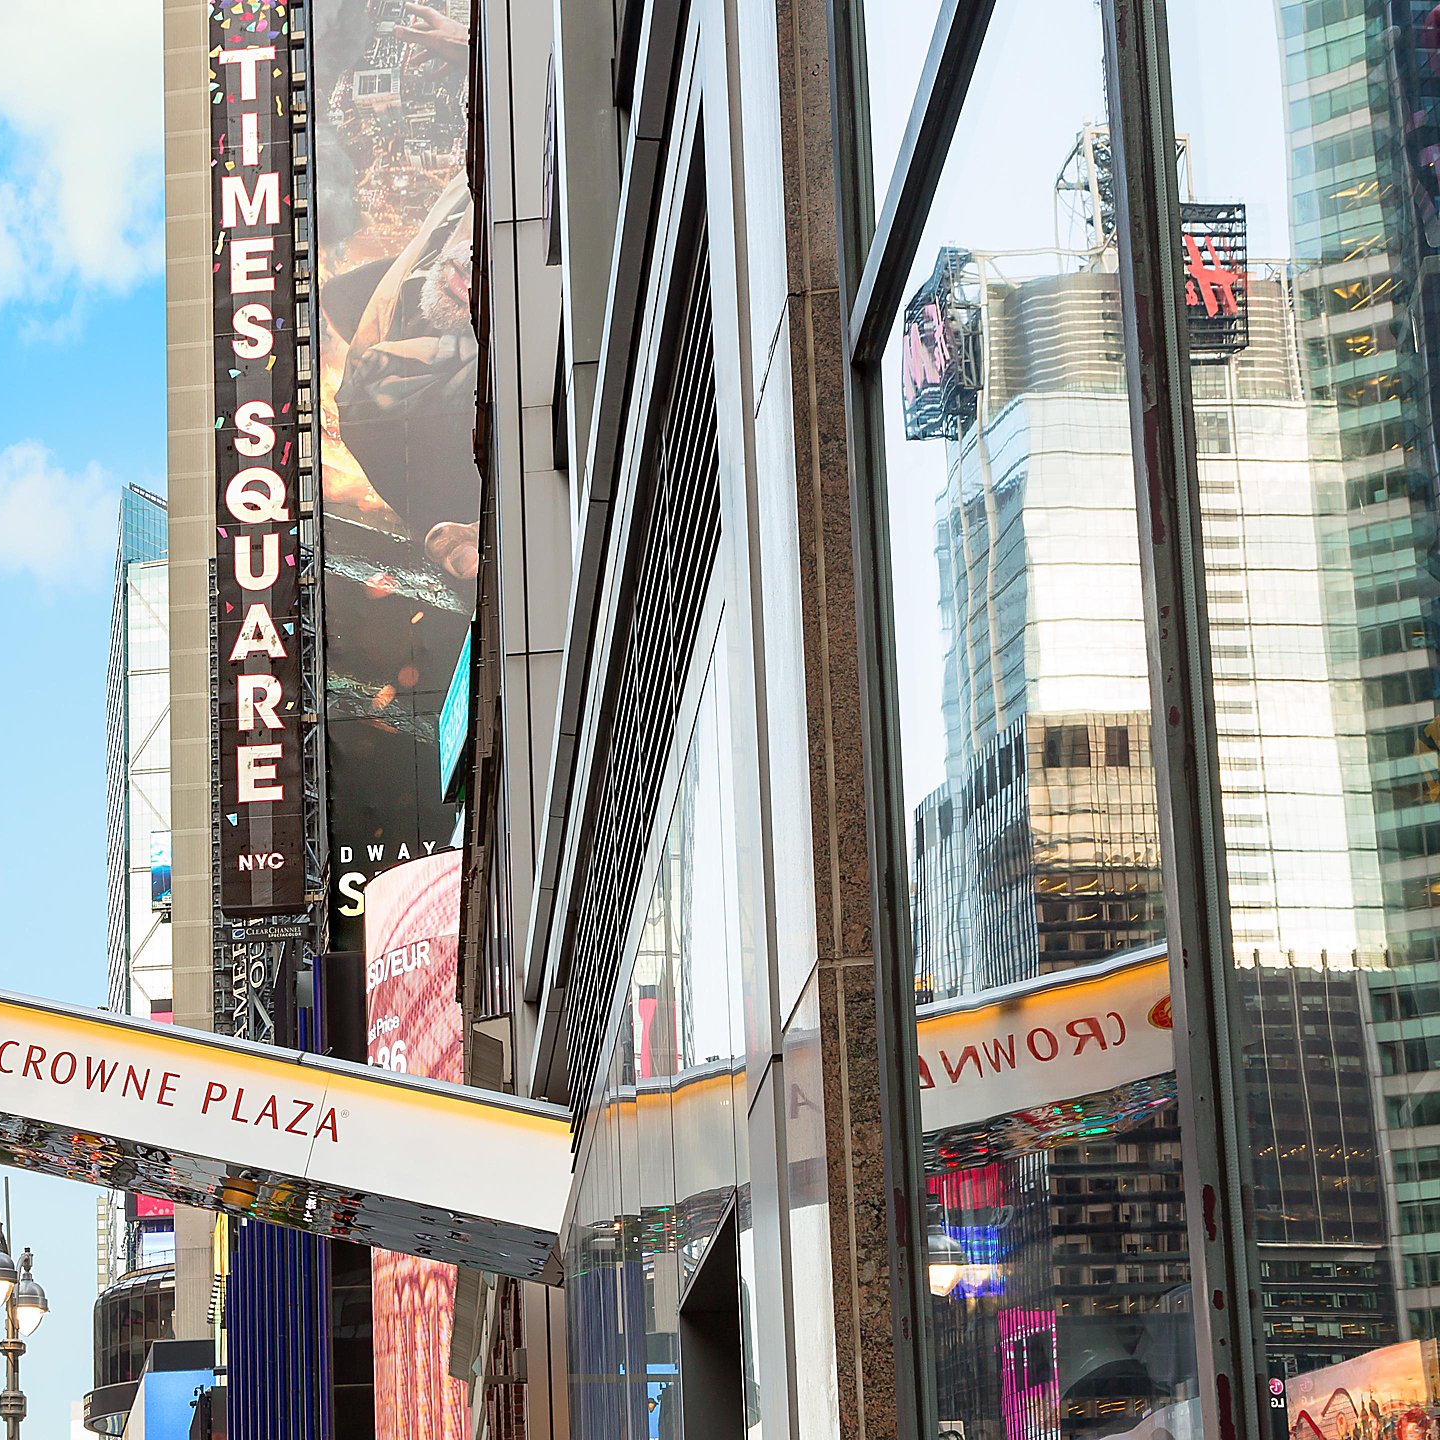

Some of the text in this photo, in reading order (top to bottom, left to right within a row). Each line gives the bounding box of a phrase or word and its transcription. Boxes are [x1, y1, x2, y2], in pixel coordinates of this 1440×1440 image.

[218, 45, 290, 804] TIMES SQUARE
[238, 852, 285, 872] NYC
[340, 840, 437, 864] DWAY
[366, 940, 431, 994] SD/EUR
[376, 1014, 400, 1037] Price
[201, 1081, 339, 1143] PLAZA
